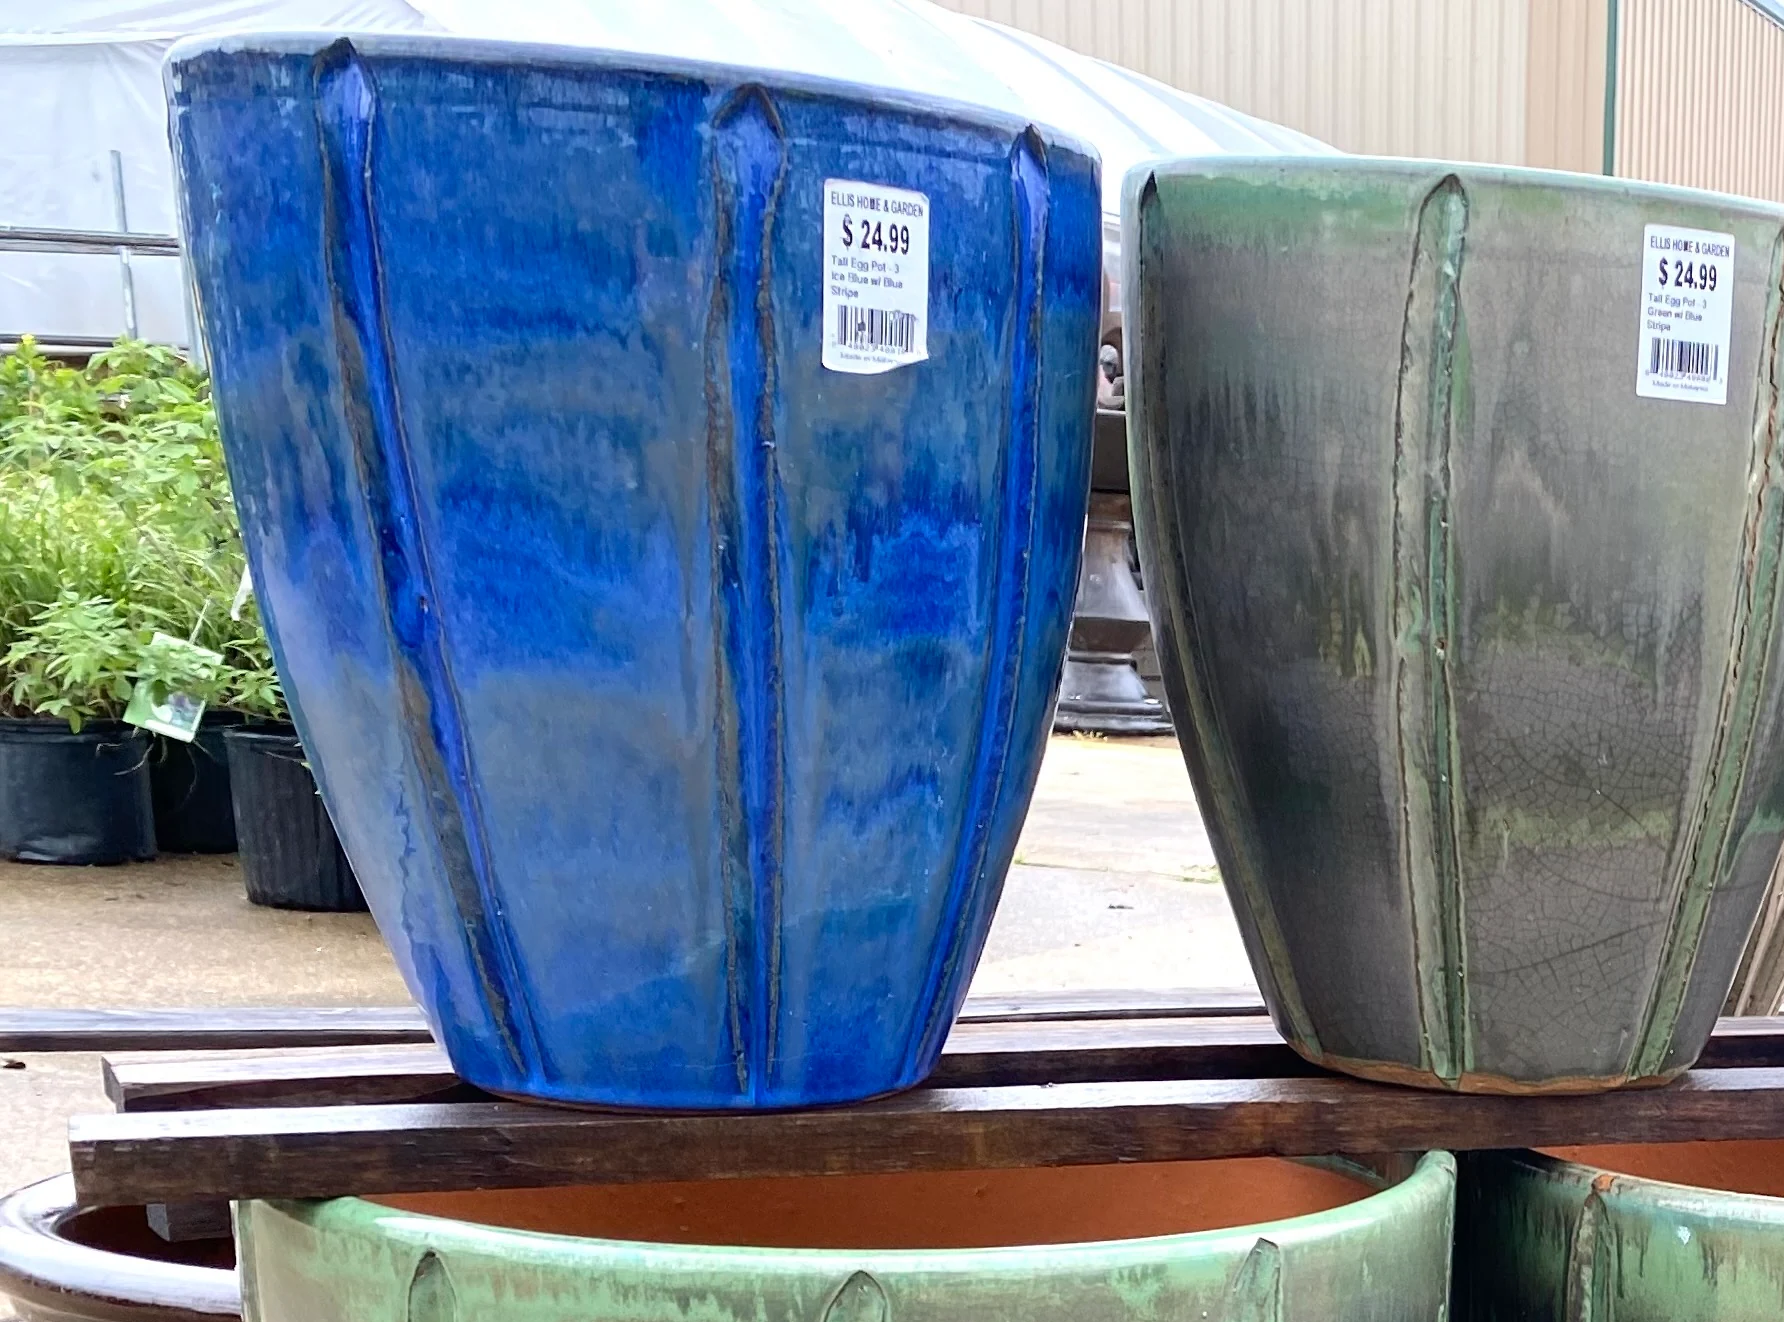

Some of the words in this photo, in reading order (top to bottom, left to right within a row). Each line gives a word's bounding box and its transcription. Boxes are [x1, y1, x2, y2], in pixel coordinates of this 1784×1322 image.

[831, 191, 855, 208] ELLIS
[857, 194, 881, 211] HOME
[883, 199, 889, 213] &
[890, 200, 923, 217] GARDEN
[842, 213, 853, 251] $
[861, 219, 909, 255] 24.99
[1650, 236, 1671, 250] ELLIS
[1673, 239, 1694, 253] HOME
[1695, 241, 1700, 254] &
[1702, 242, 1730, 258] GARDEN
[831, 255, 848, 266] Tall
[851, 256, 869, 272] Egg
[871, 260, 886, 272] Pot
[831, 271, 845, 281] Ice
[848, 272, 868, 284] Blue
[884, 277, 903, 289] Blue
[1658, 256, 1668, 290] $
[1674, 260, 1717, 291] 24.99
[831, 285, 859, 300] Stripe
[1648, 292, 1663, 303] Tall
[1665, 294, 1681, 307] Egg
[1683, 296, 1695, 307] Pot
[1647, 306, 1672, 318] Green
[1685, 310, 1703, 322] Blue
[1647, 319, 1671, 333] Stripe
